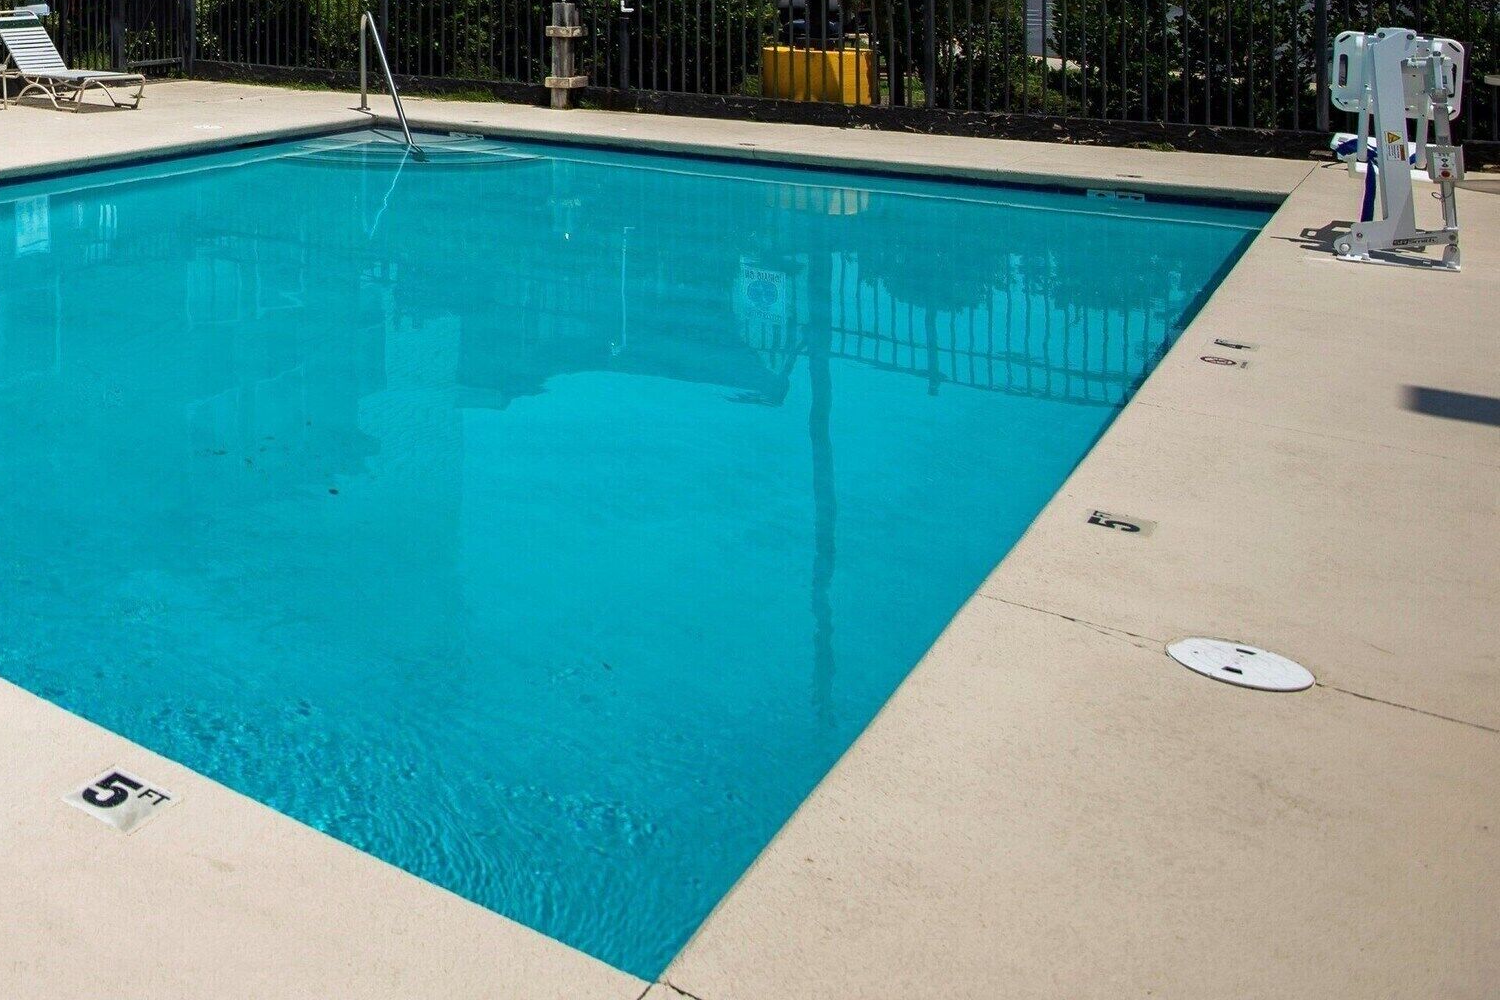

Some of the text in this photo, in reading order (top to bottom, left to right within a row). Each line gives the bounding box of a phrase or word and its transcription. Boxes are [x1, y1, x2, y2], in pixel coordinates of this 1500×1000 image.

[1087, 515, 1141, 533] 5
[82, 771, 171, 808] 5 FT
